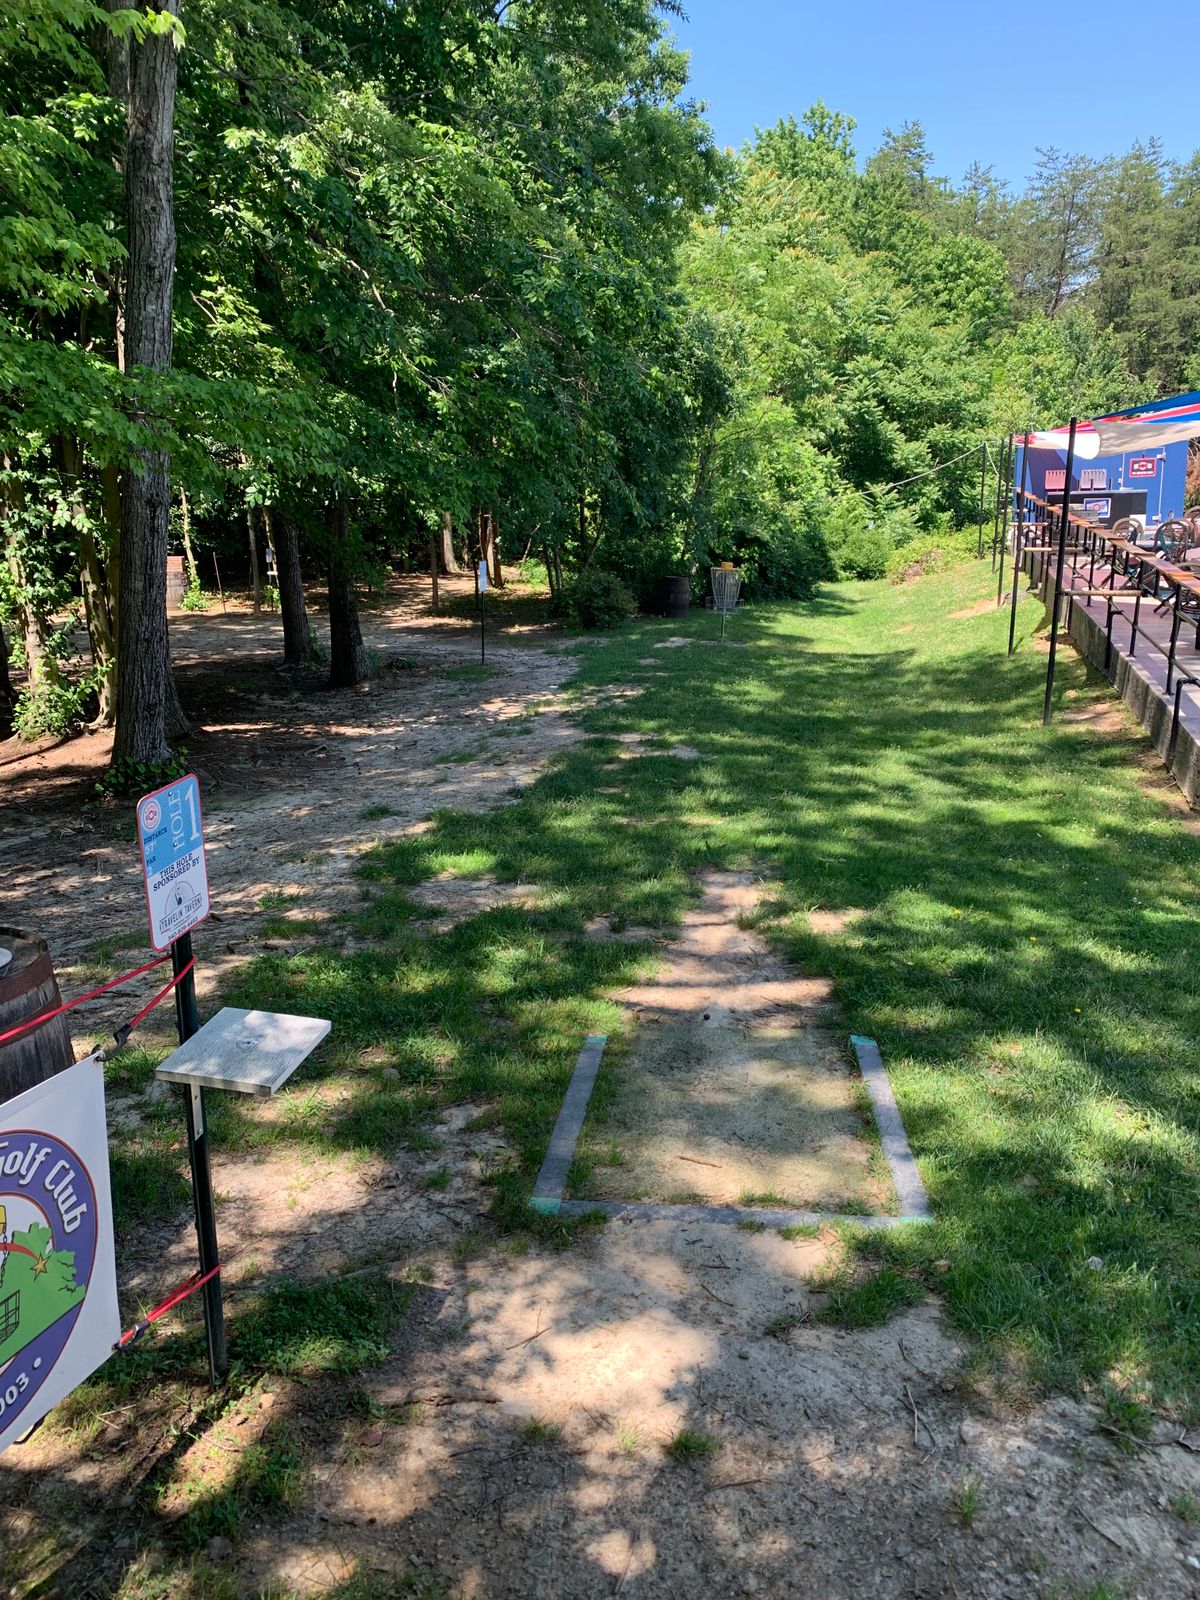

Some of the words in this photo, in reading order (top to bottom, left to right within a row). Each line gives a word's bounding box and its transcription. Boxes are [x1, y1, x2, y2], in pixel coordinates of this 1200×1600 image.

[168, 790, 185, 852] HOLE
[185, 784, 200, 841] 1
[144, 827, 168, 844] DISTANCE
[146, 855, 156, 866] PAR
[153, 863, 191, 892] SPONSORED
[193, 856, 200, 869] BY
[159, 864, 175, 879] THIS
[176, 853, 193, 869] HOLE
[184, 897, 201, 915] TAVERN
[44, 1160, 87, 1233] Club
